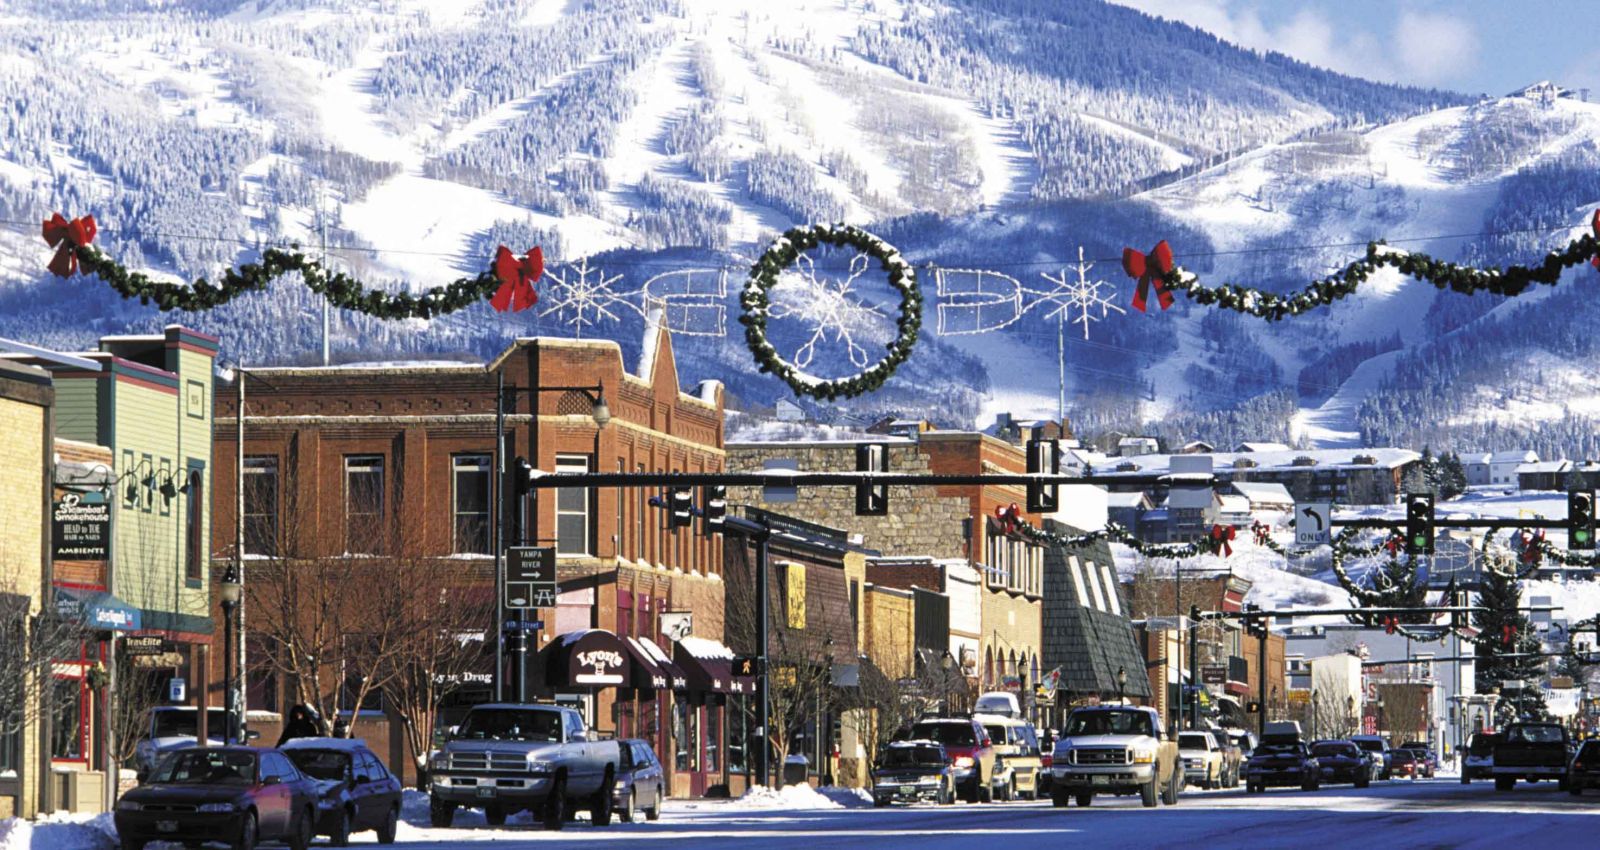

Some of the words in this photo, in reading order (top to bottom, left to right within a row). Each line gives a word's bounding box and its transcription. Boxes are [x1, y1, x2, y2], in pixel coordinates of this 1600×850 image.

[59, 503, 107, 514] Steamboat
[54, 510, 109, 522] Smokehouse
[63, 523, 81, 534] HEAD
[88, 523, 101, 534] TOE
[1300, 532, 1326, 542] ONLY
[57, 547, 105, 555] AMBIENTE
[519, 550, 543, 558] YAMPA
[521, 560, 541, 569] RIVER
[126, 637, 162, 647] TravElite
[576, 650, 624, 668] Lyon's
[462, 671, 493, 684] Drug
